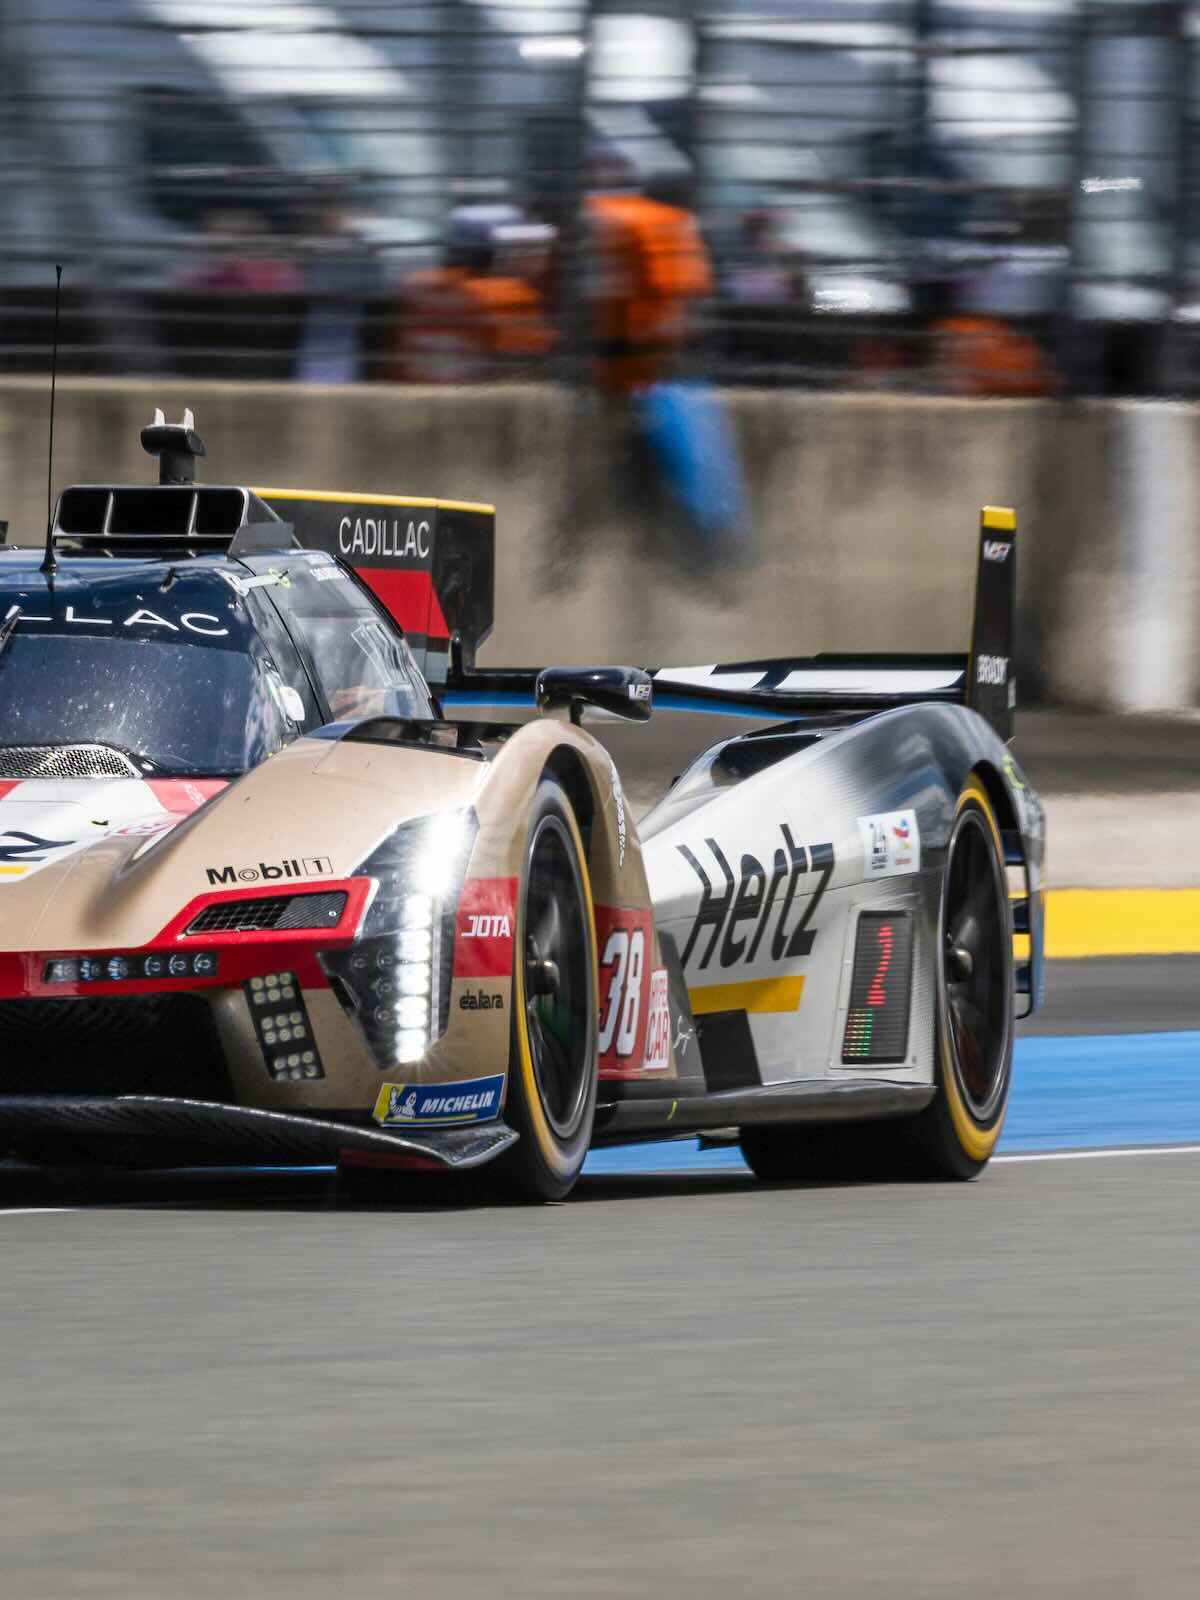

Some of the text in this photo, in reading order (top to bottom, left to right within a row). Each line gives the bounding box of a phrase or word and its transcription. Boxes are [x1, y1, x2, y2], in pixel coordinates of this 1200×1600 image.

[339, 516, 430, 558] CADILLAC
[206, 859, 302, 885] Mobil
[674, 823, 835, 970] Hertz
[460, 914, 511, 937] JOTA
[597, 928, 645, 1054] 38
[420, 1089, 495, 1114] MICHELIN
